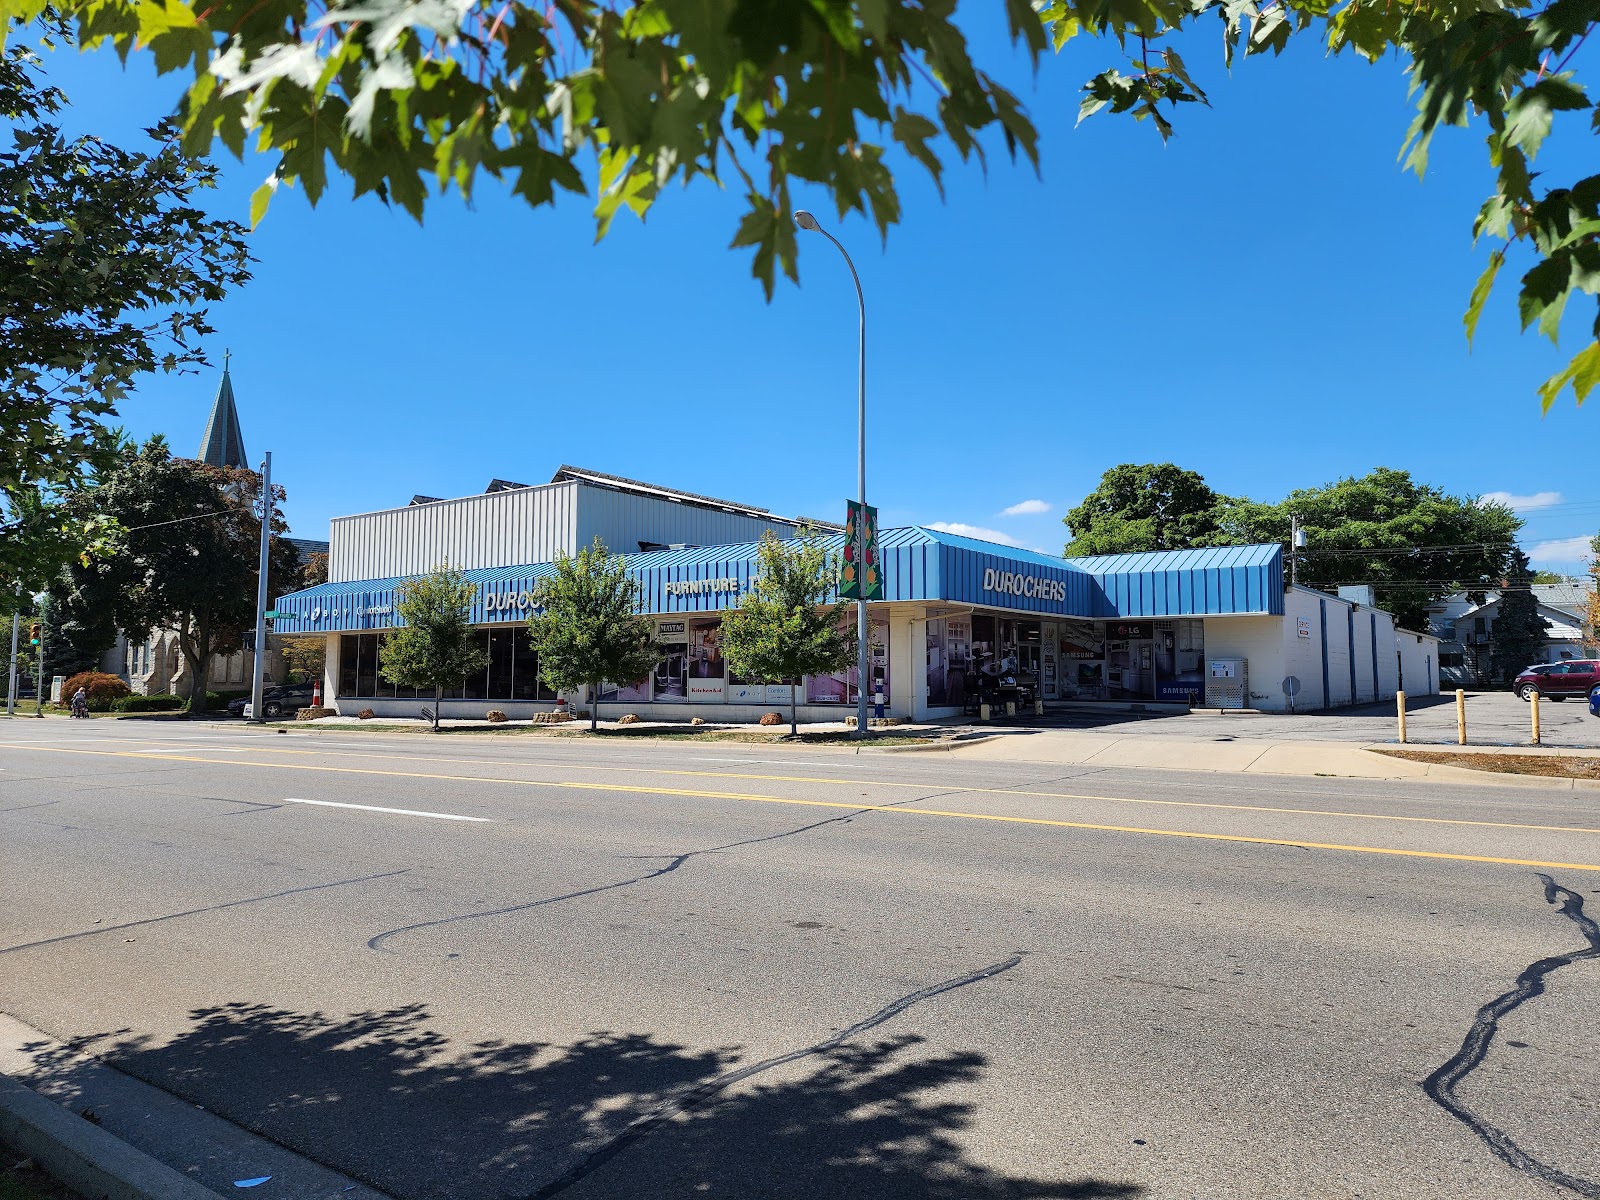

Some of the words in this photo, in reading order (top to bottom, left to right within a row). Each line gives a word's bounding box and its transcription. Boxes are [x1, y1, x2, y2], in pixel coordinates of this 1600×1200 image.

[665, 577, 738, 595] FURNITURE
[983, 568, 1066, 602] DUROCHERS
[485, 590, 542, 611] DUROC
[660, 624, 684, 632] MAYTAG
